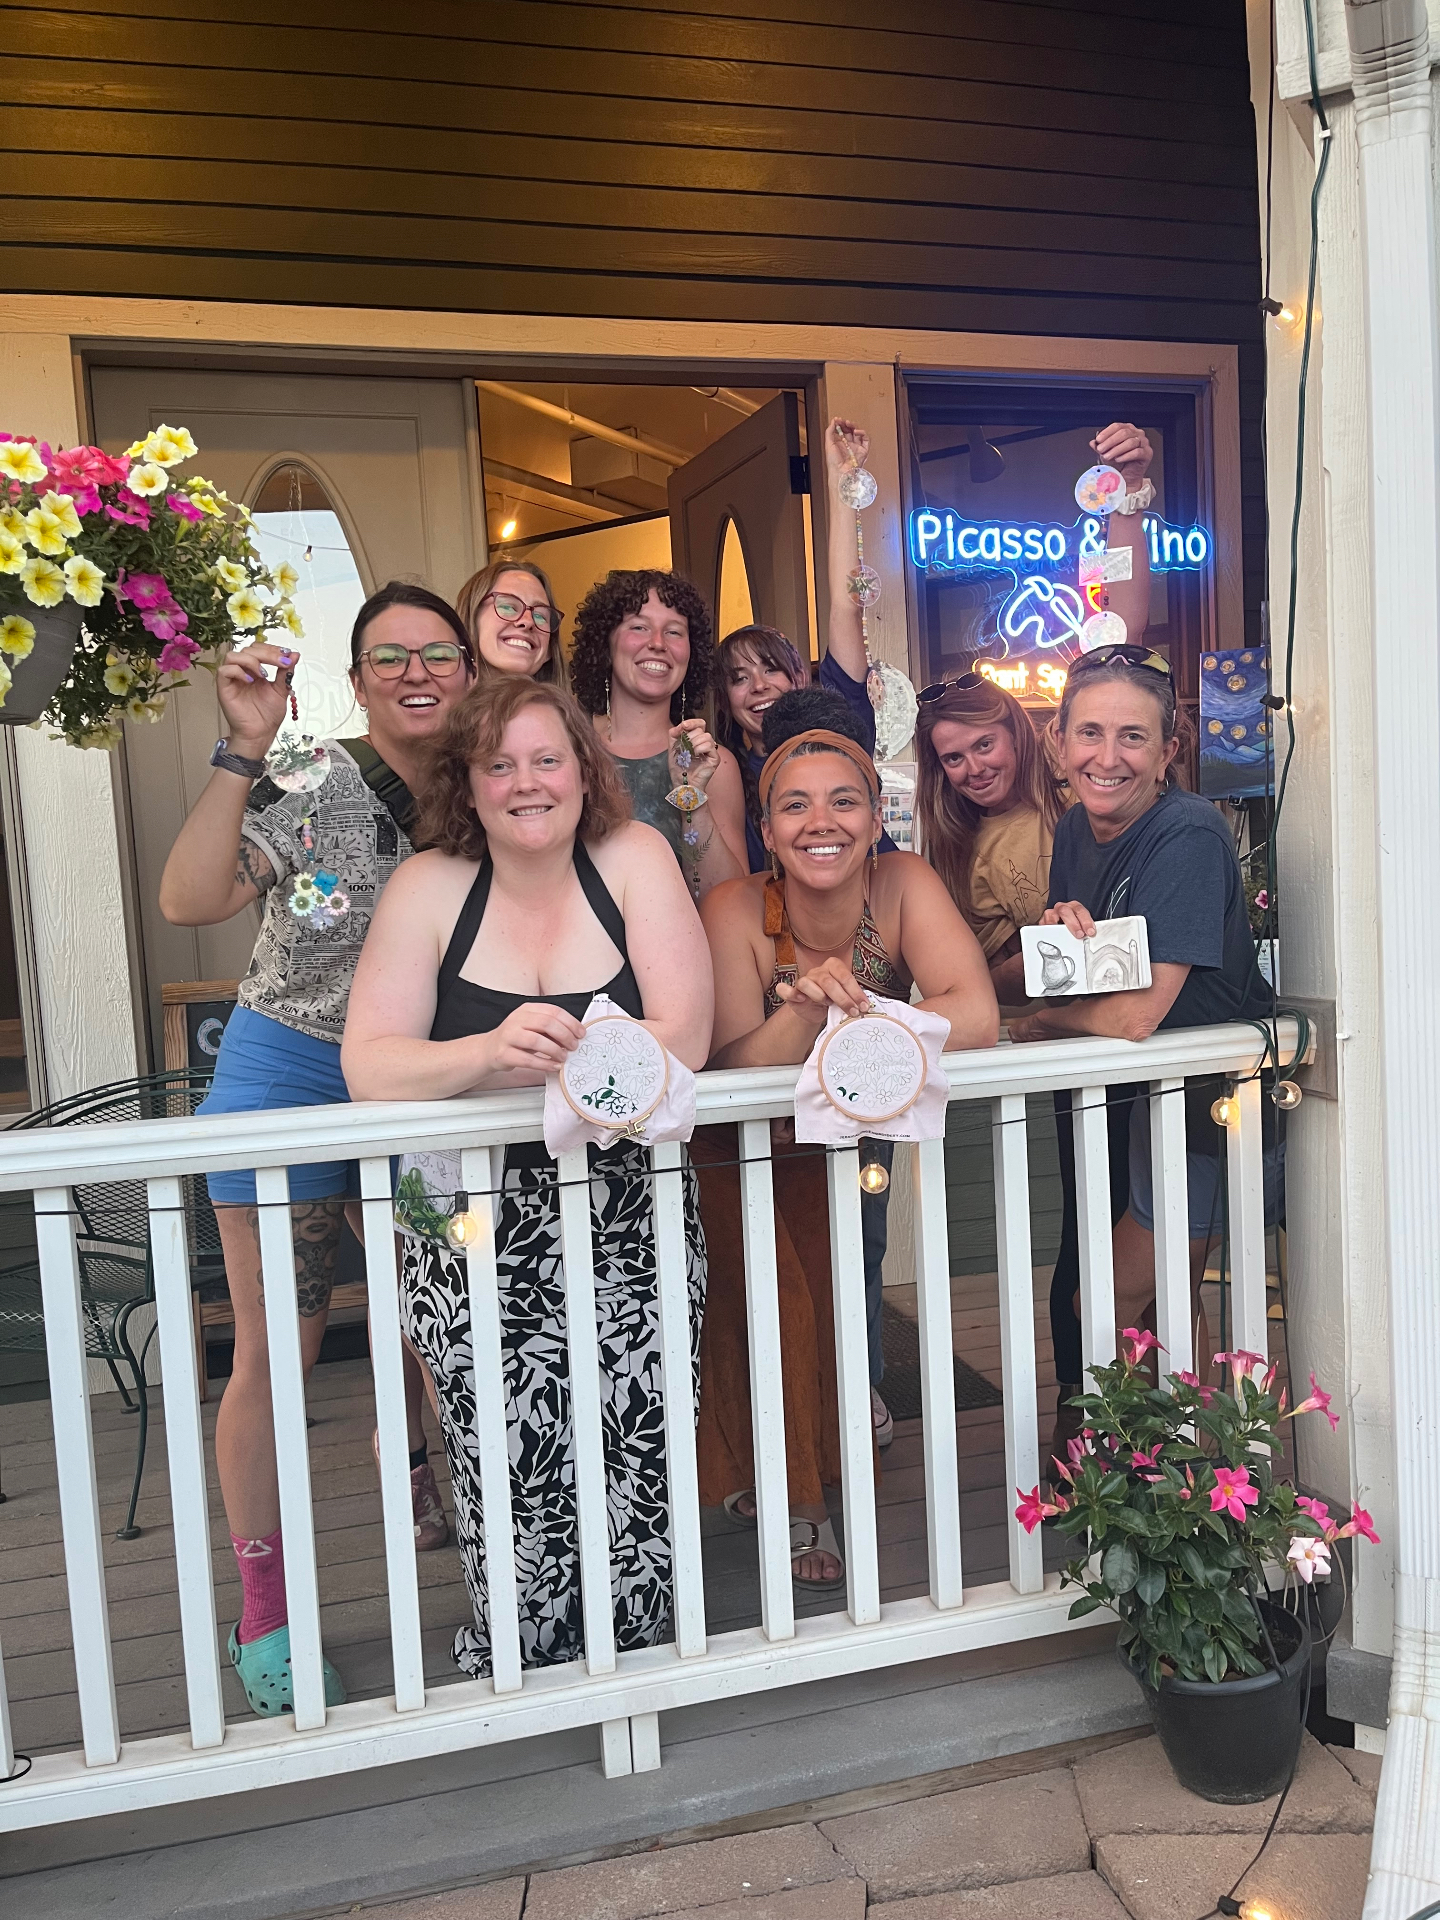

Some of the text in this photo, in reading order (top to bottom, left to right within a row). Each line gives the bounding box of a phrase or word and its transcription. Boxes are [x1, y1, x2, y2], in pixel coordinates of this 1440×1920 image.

[916, 513, 1208, 564] Picasso & ino
[278, 1003, 300, 1015] SUN
[301, 1010, 310, 1019] &
